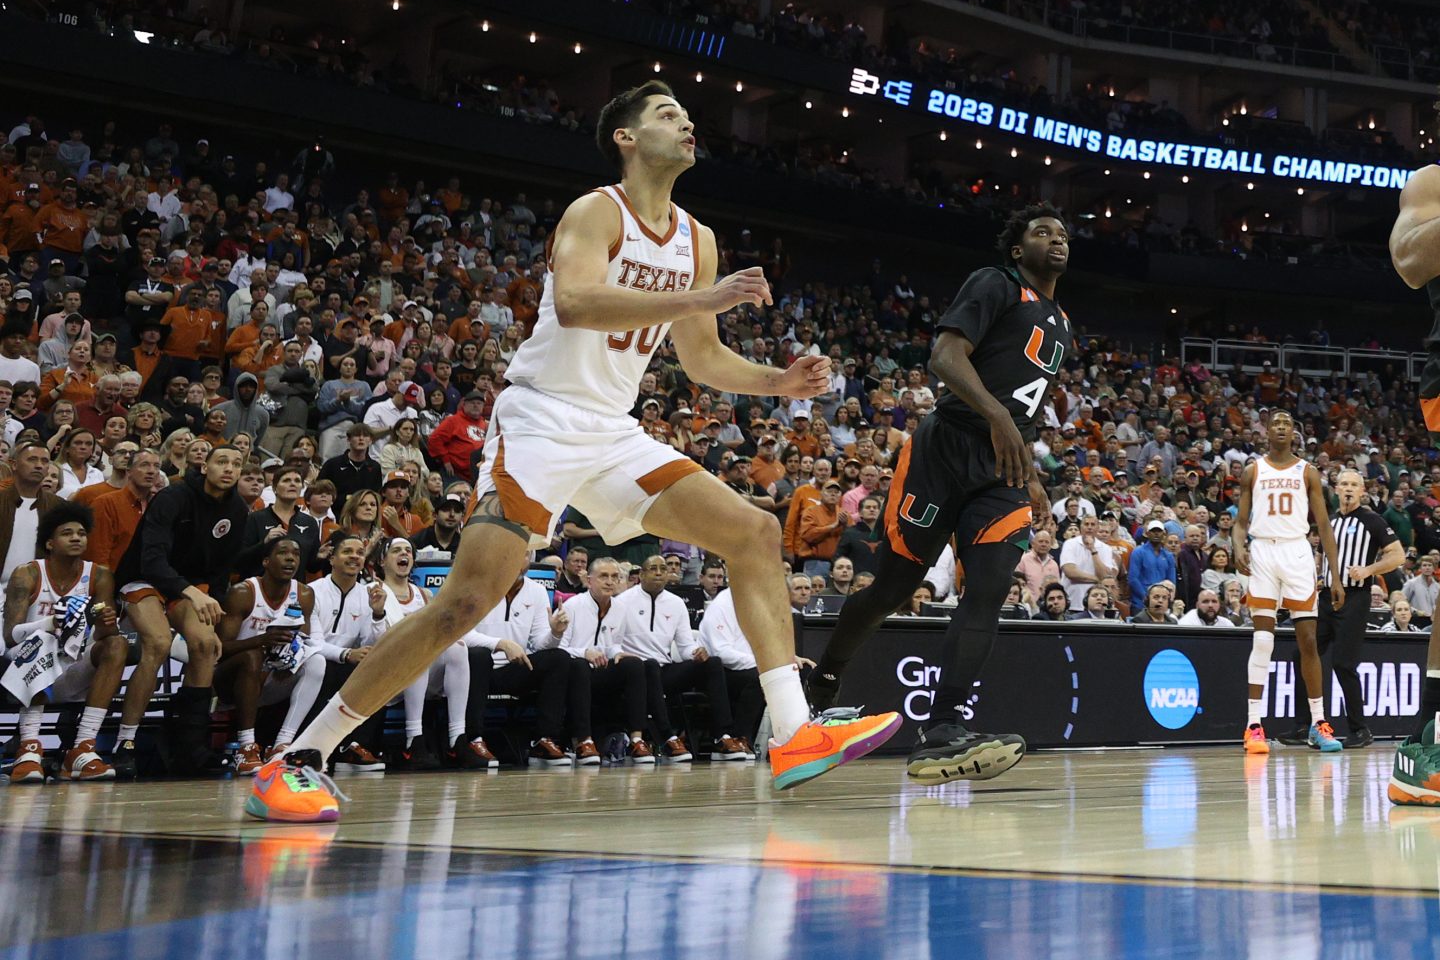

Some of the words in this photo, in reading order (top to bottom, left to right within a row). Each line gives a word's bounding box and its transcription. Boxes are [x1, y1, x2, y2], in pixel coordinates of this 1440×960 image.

[57, 11, 79, 27] 106
[926, 89, 994, 126] 2023
[998, 106, 1029, 135] DI
[1033, 115, 1102, 153] MEN'S
[1105, 134, 1267, 175] BASKETBALL
[1272, 154, 1417, 190] CHAMPION
[617, 257, 692, 292] TEXAS
[1012, 377, 1049, 418] 4
[1260, 478, 1301, 490] TEXAS
[1267, 493, 1293, 516] 10
[1151, 687, 1198, 708] NCAA
